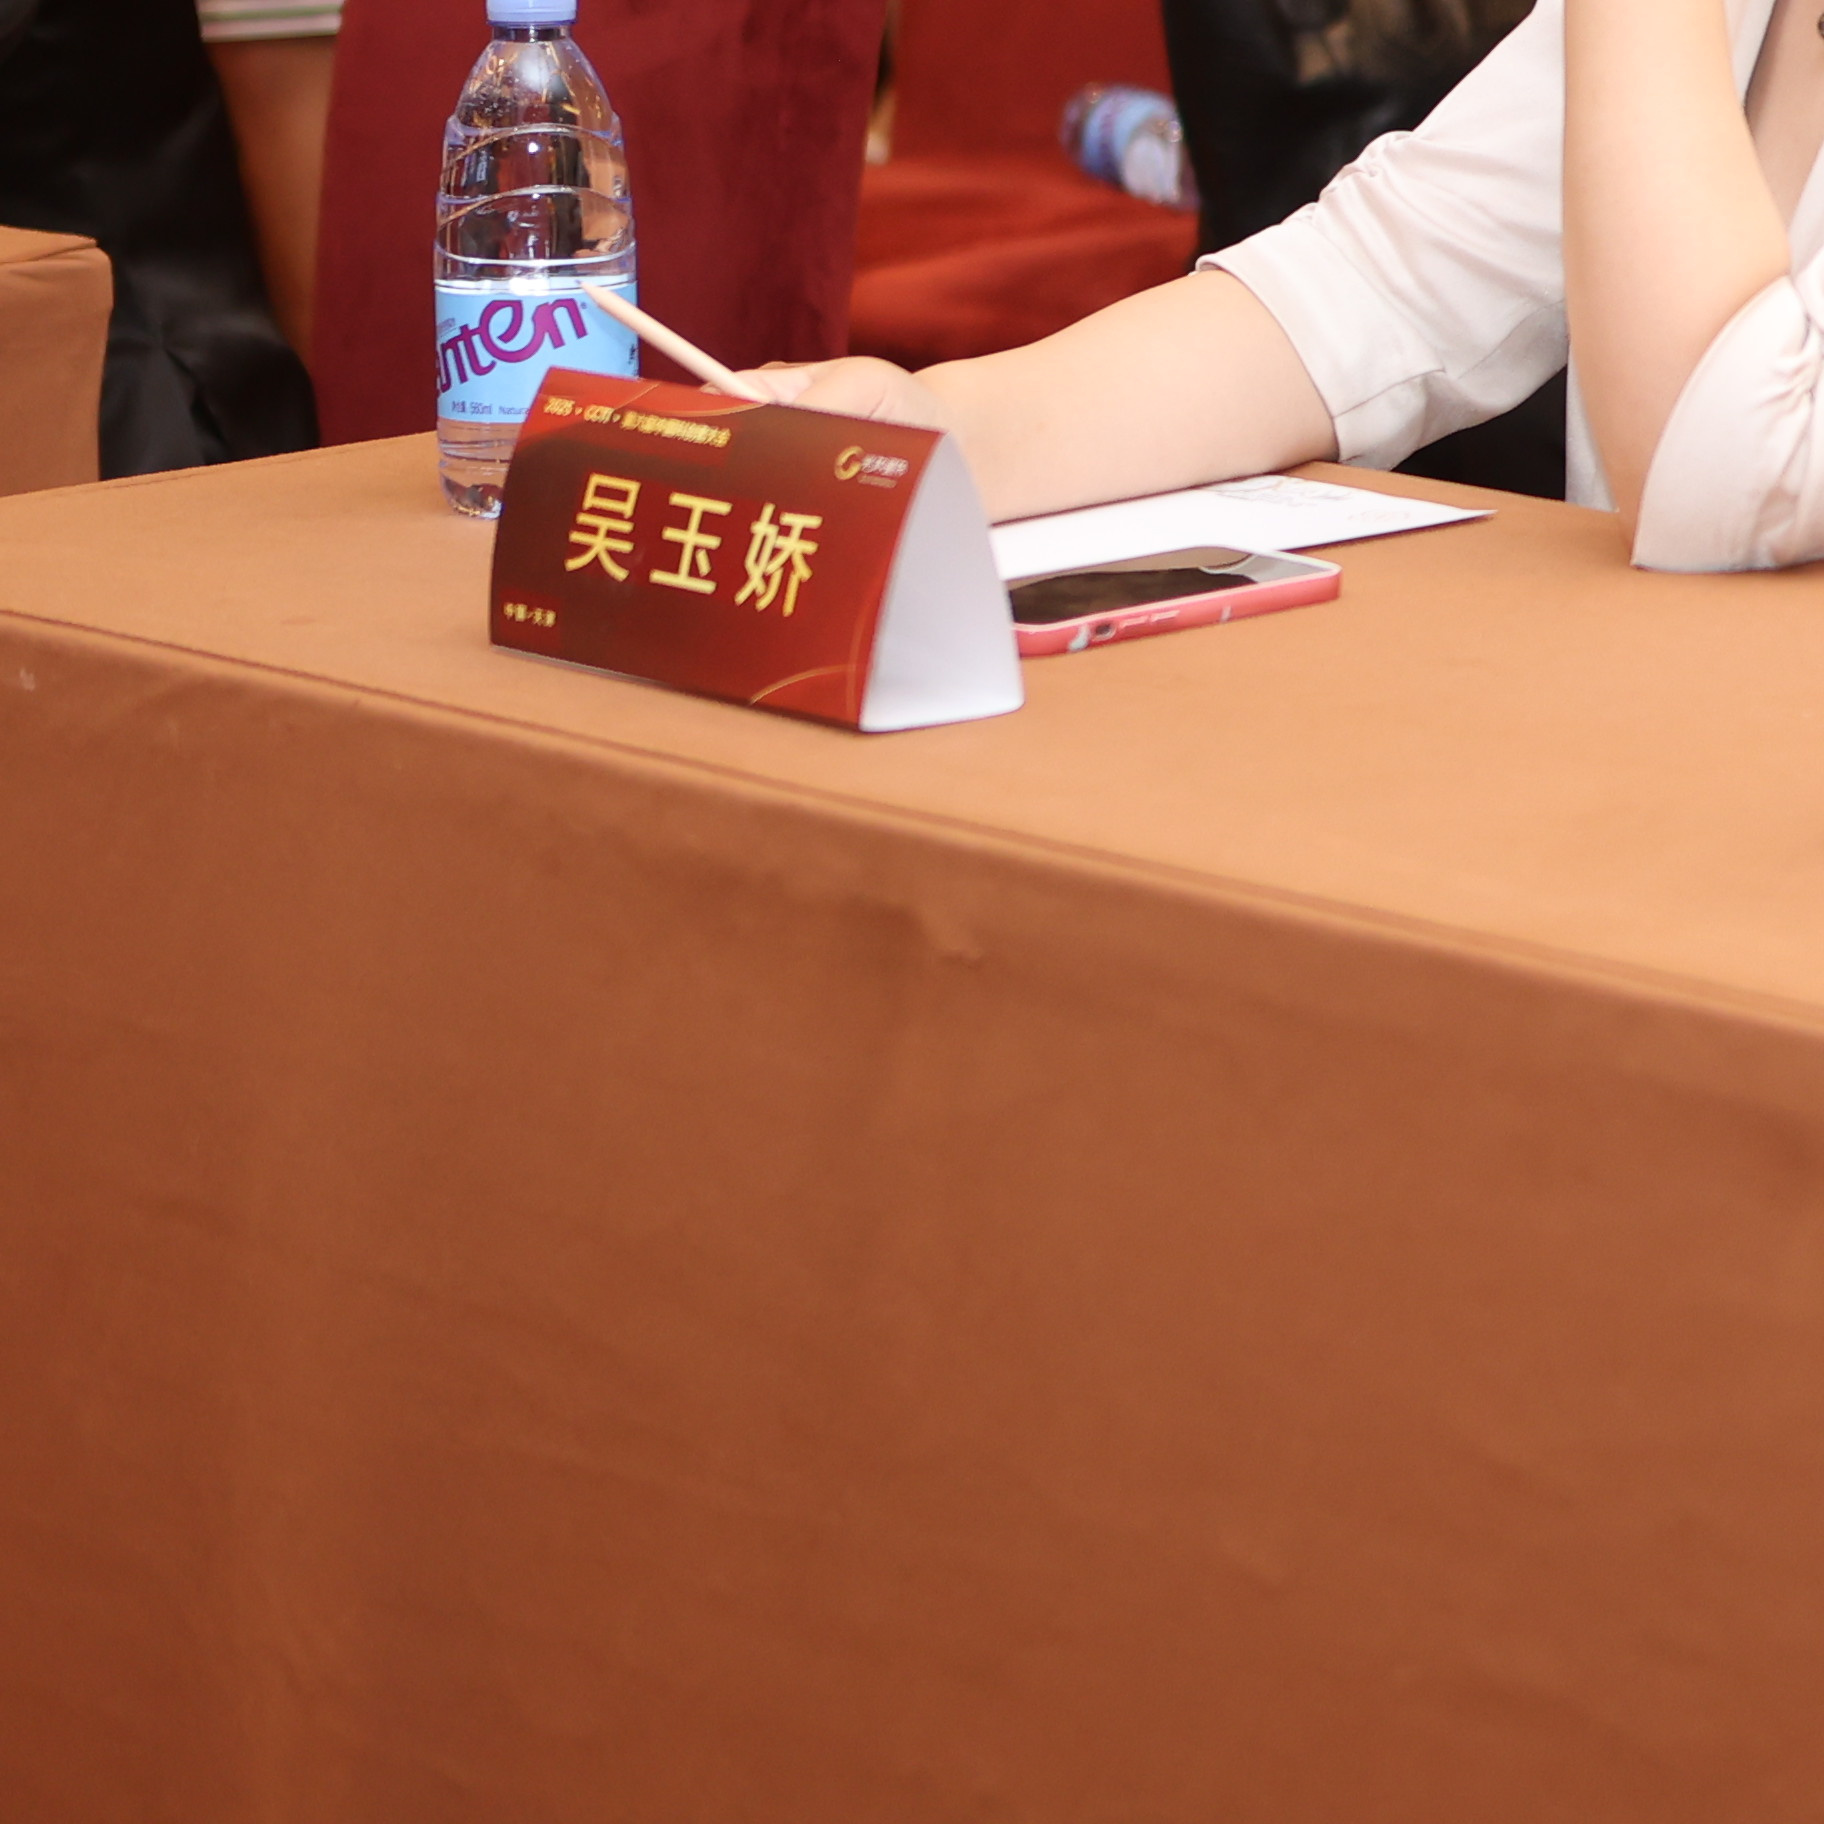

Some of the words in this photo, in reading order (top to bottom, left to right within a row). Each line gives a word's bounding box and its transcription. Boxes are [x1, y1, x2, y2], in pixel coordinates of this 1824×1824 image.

[435, 297, 588, 394] nten
[564, 472, 823, 617] 吴玉娇
